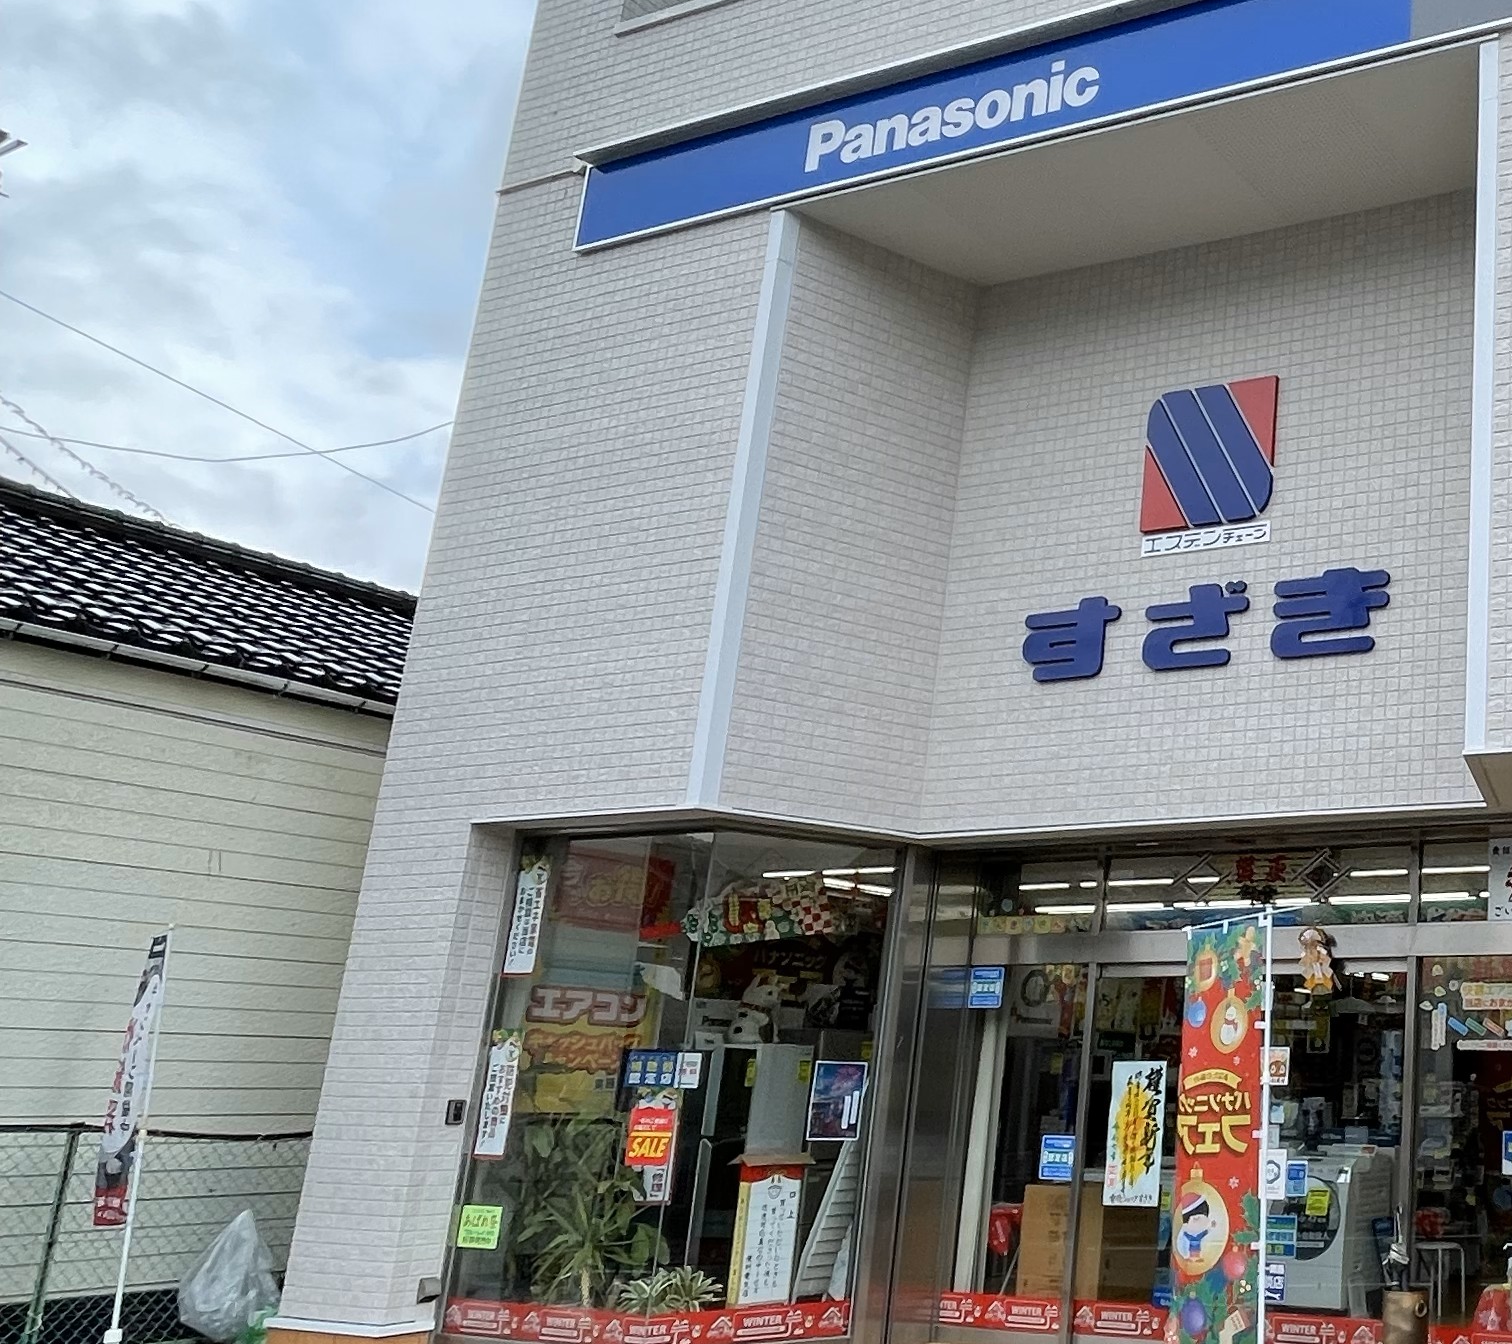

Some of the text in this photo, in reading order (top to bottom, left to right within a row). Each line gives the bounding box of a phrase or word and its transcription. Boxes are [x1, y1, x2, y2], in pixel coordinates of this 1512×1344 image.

[804, 60, 1101, 172] Panasonic
[1022, 567, 1391, 683] すざき
[530, 987, 648, 1024] エアコン
[628, 1137, 670, 1158] SALE
[1011, 1305, 1043, 1318] WINTER
[1100, 1311, 1134, 1323] WINTER
[742, 1313, 784, 1329] WINTER
[1281, 1322, 1318, 1337] WINTER
